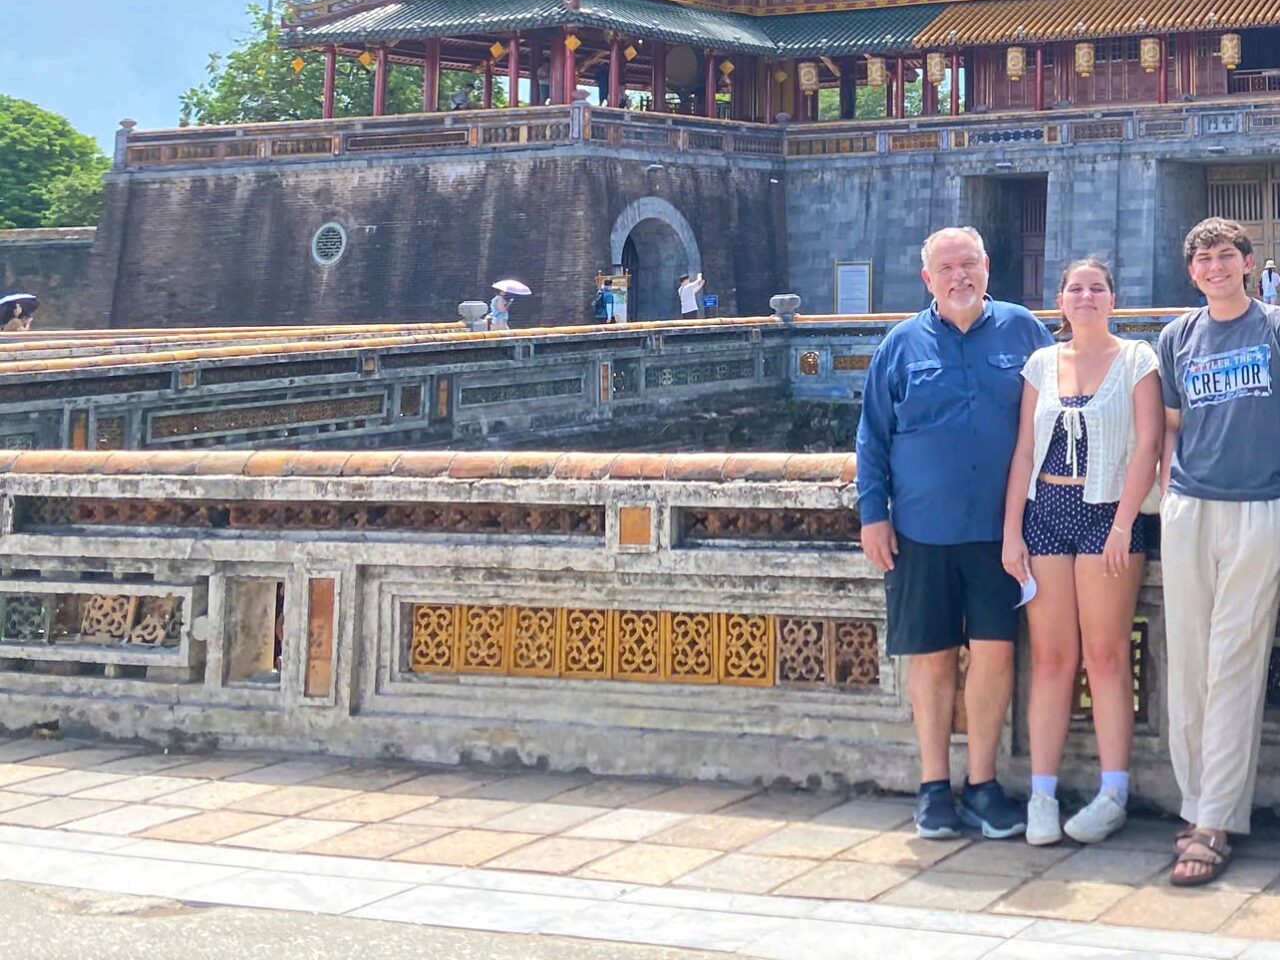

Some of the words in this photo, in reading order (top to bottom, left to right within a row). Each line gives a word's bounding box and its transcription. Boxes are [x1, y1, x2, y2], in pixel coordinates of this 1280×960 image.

[1199, 358, 1230, 372] TYLER
[1233, 353, 1253, 365] THE
[1192, 363, 1261, 396] CREATOR
